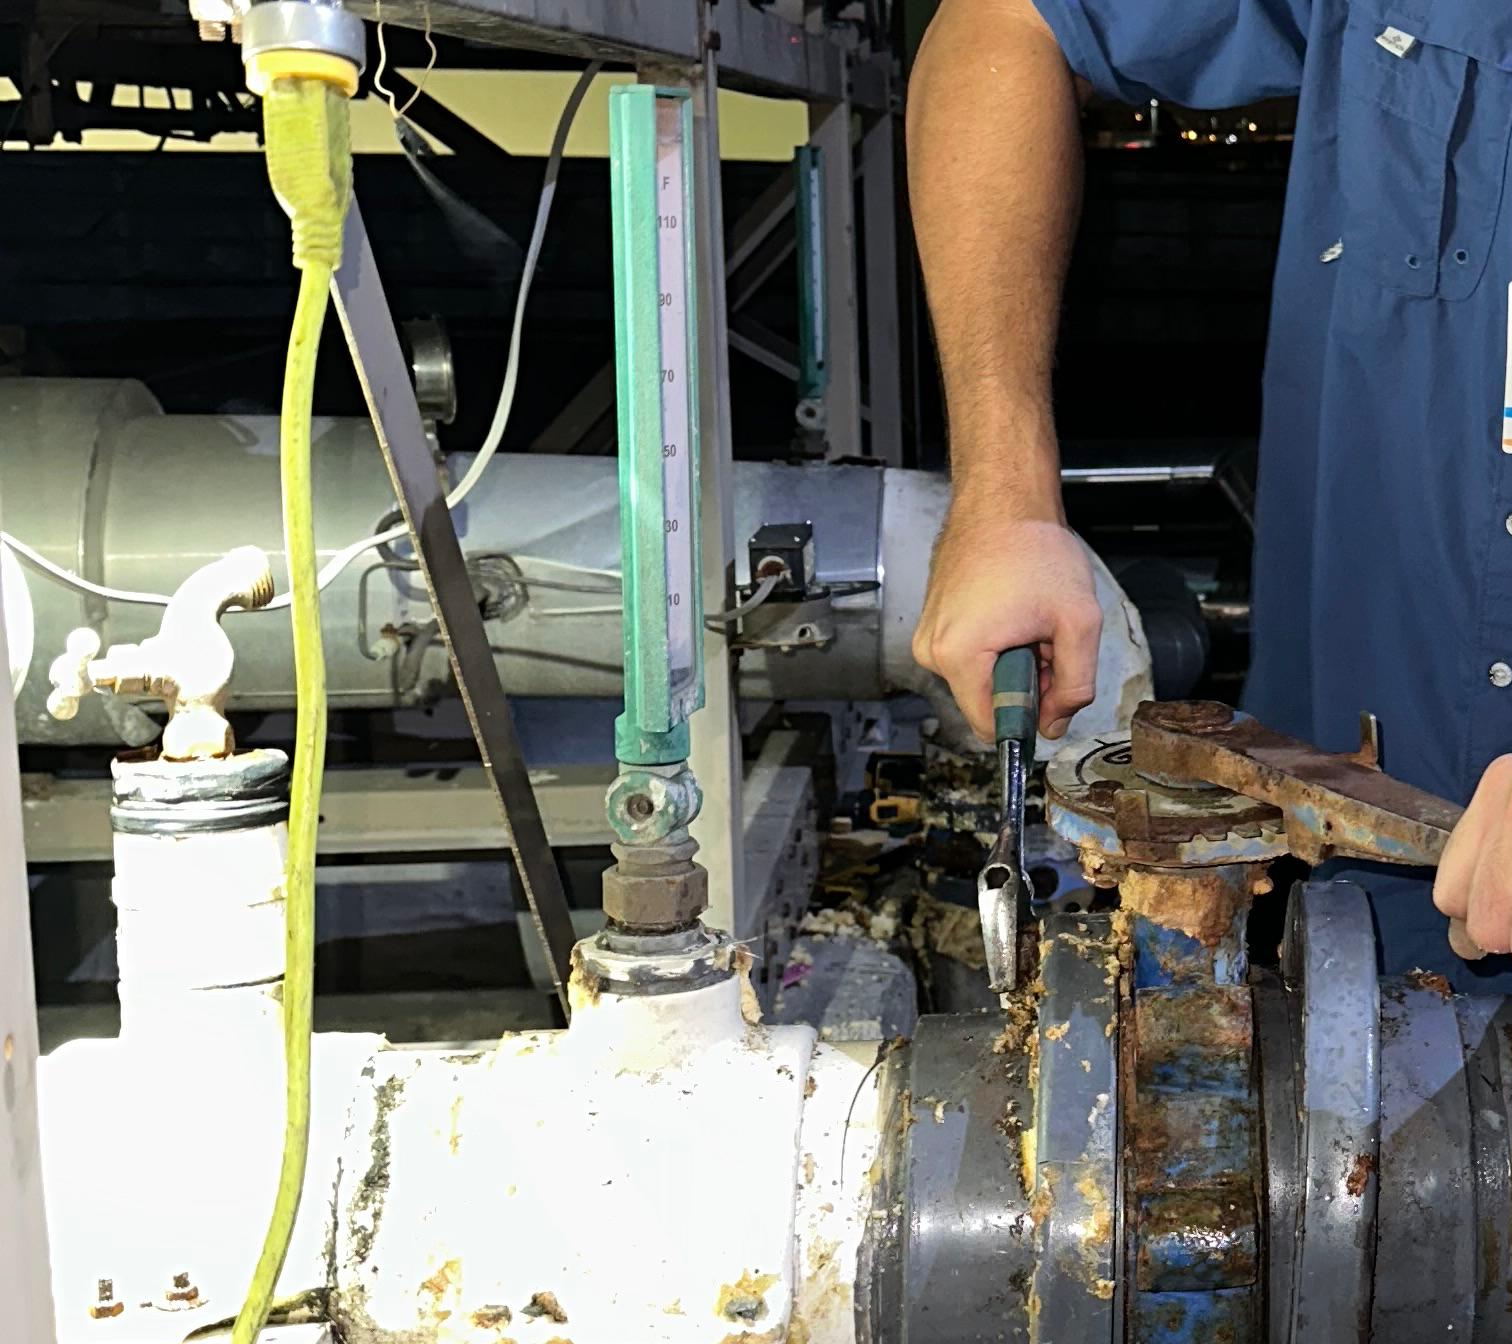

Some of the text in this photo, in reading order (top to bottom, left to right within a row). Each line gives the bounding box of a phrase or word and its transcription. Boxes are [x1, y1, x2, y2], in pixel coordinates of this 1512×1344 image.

[657, 215, 677, 229] 110
[660, 293, 672, 307] 90
[661, 369, 675, 384] 70
[663, 444, 677, 458] 50
[664, 519, 679, 533] 30
[667, 593, 680, 606] 10
